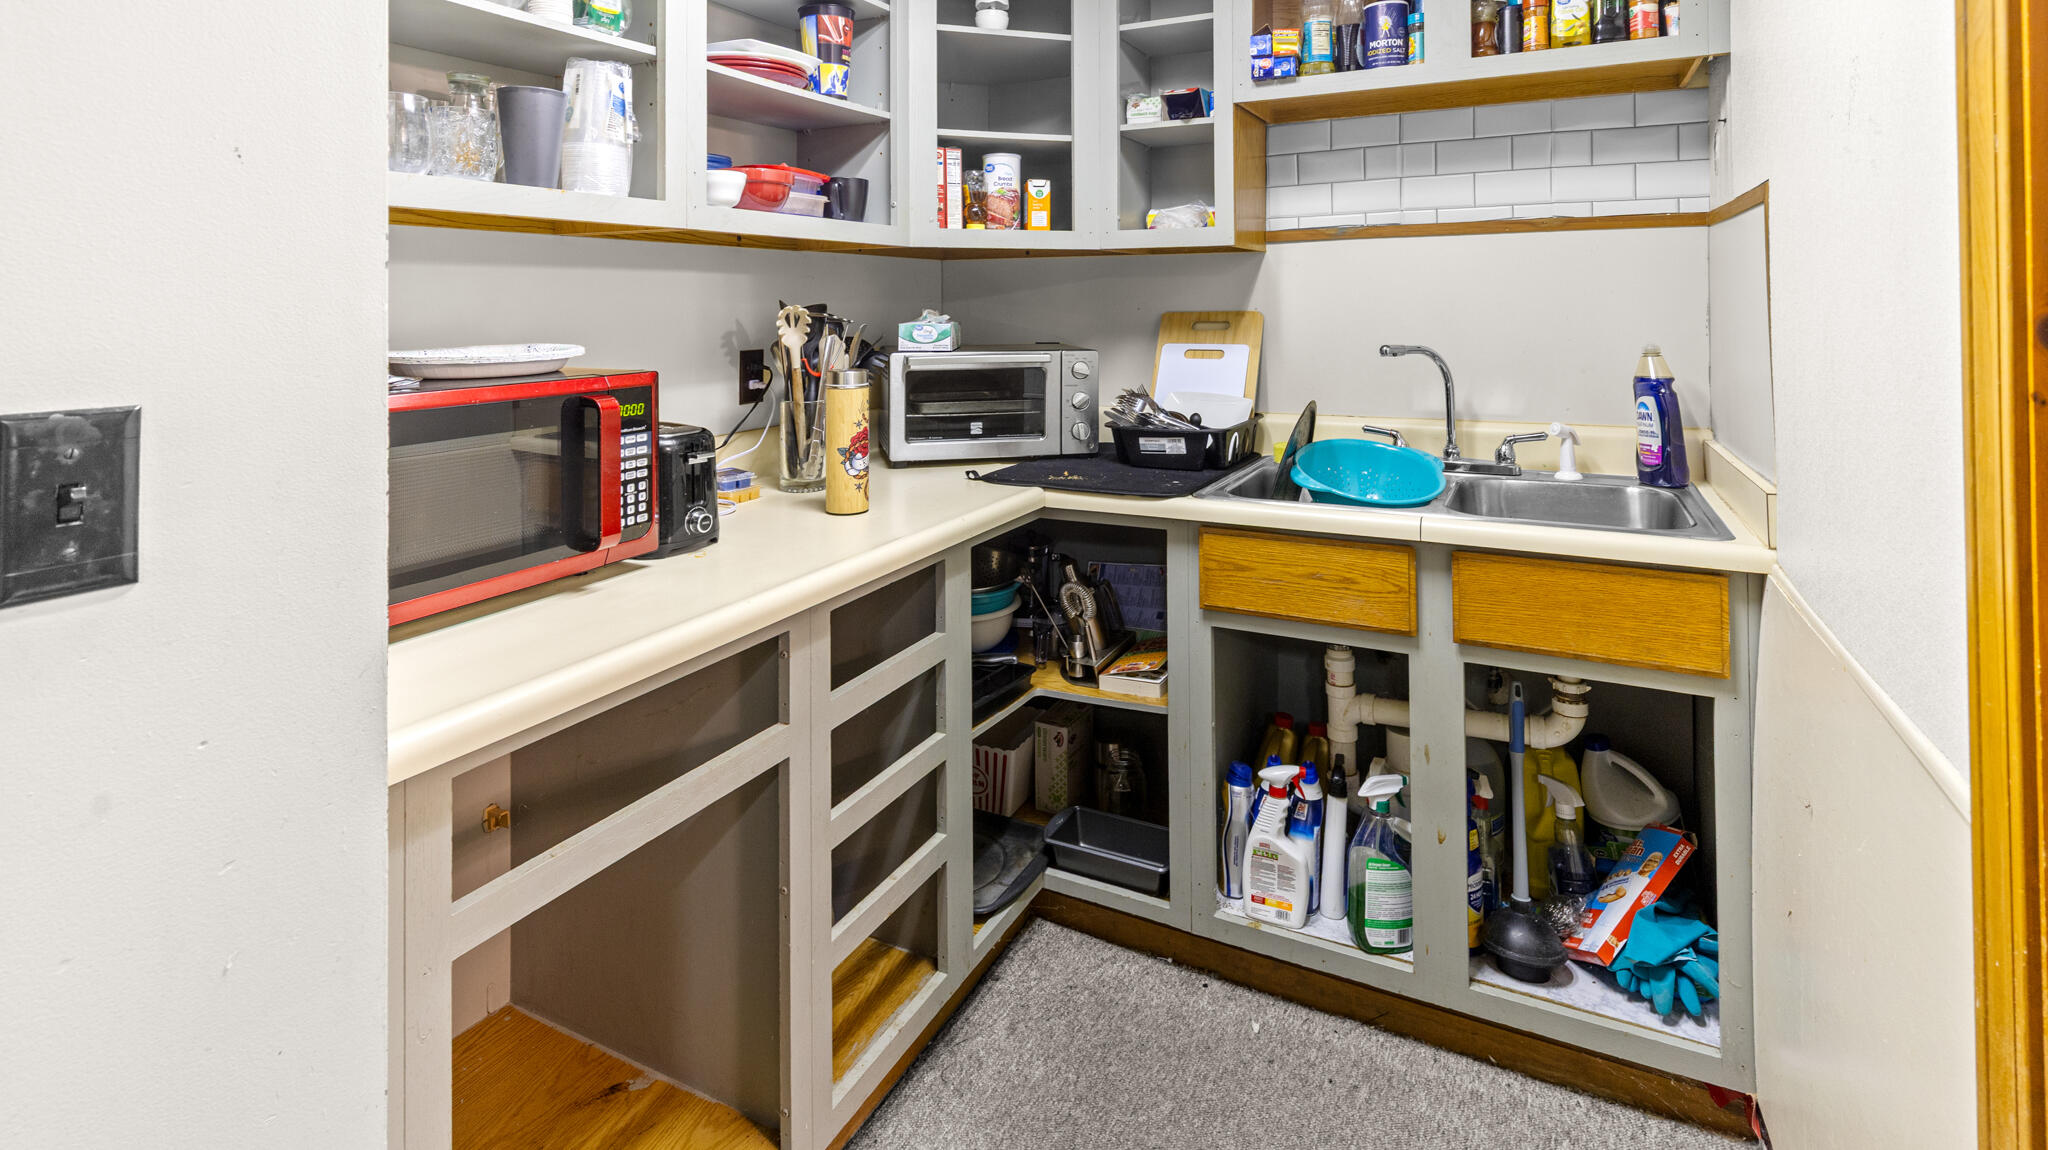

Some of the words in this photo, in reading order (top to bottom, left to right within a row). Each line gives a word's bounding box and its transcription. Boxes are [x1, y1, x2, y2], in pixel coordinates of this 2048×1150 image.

[1369, 39, 1404, 49] MORTON
[1367, 47, 1392, 56] IODIZED
[1673, 843, 1685, 858] EXTRA
[1675, 845, 1692, 866] DURABLE
